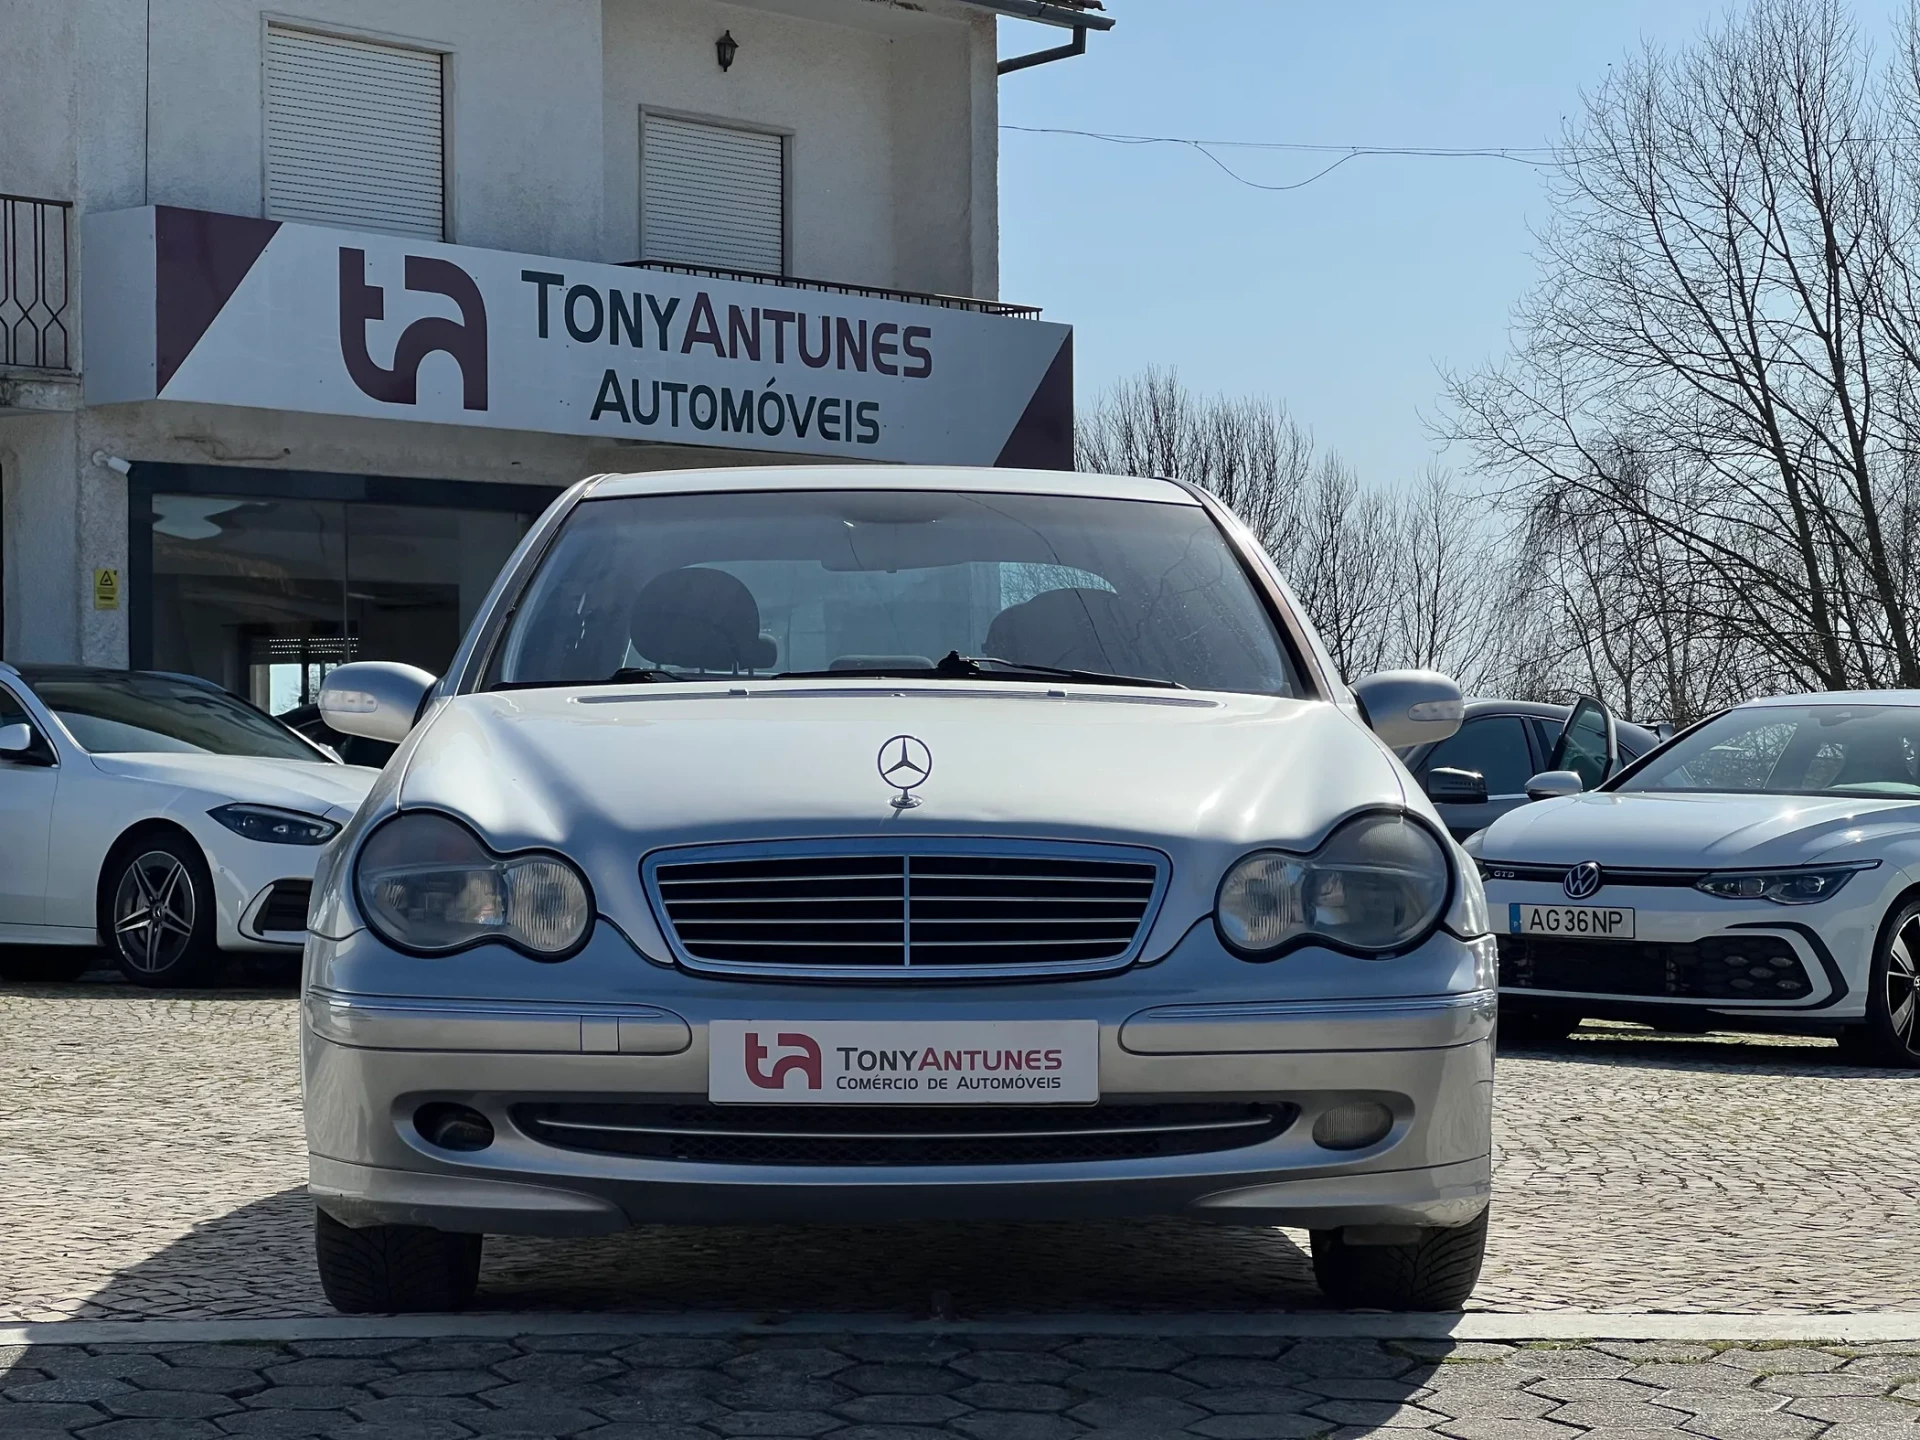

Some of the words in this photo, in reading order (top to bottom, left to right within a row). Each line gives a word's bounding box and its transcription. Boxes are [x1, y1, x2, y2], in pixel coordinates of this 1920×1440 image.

[590, 369, 880, 444] AUTOMÓVEIS
[1494, 870, 1515, 878] GTD
[836, 1074, 919, 1091] COMÉRCIO
[927, 1076, 948, 1090] DE
[956, 1073, 1062, 1090] AUTOMÓVEIS
